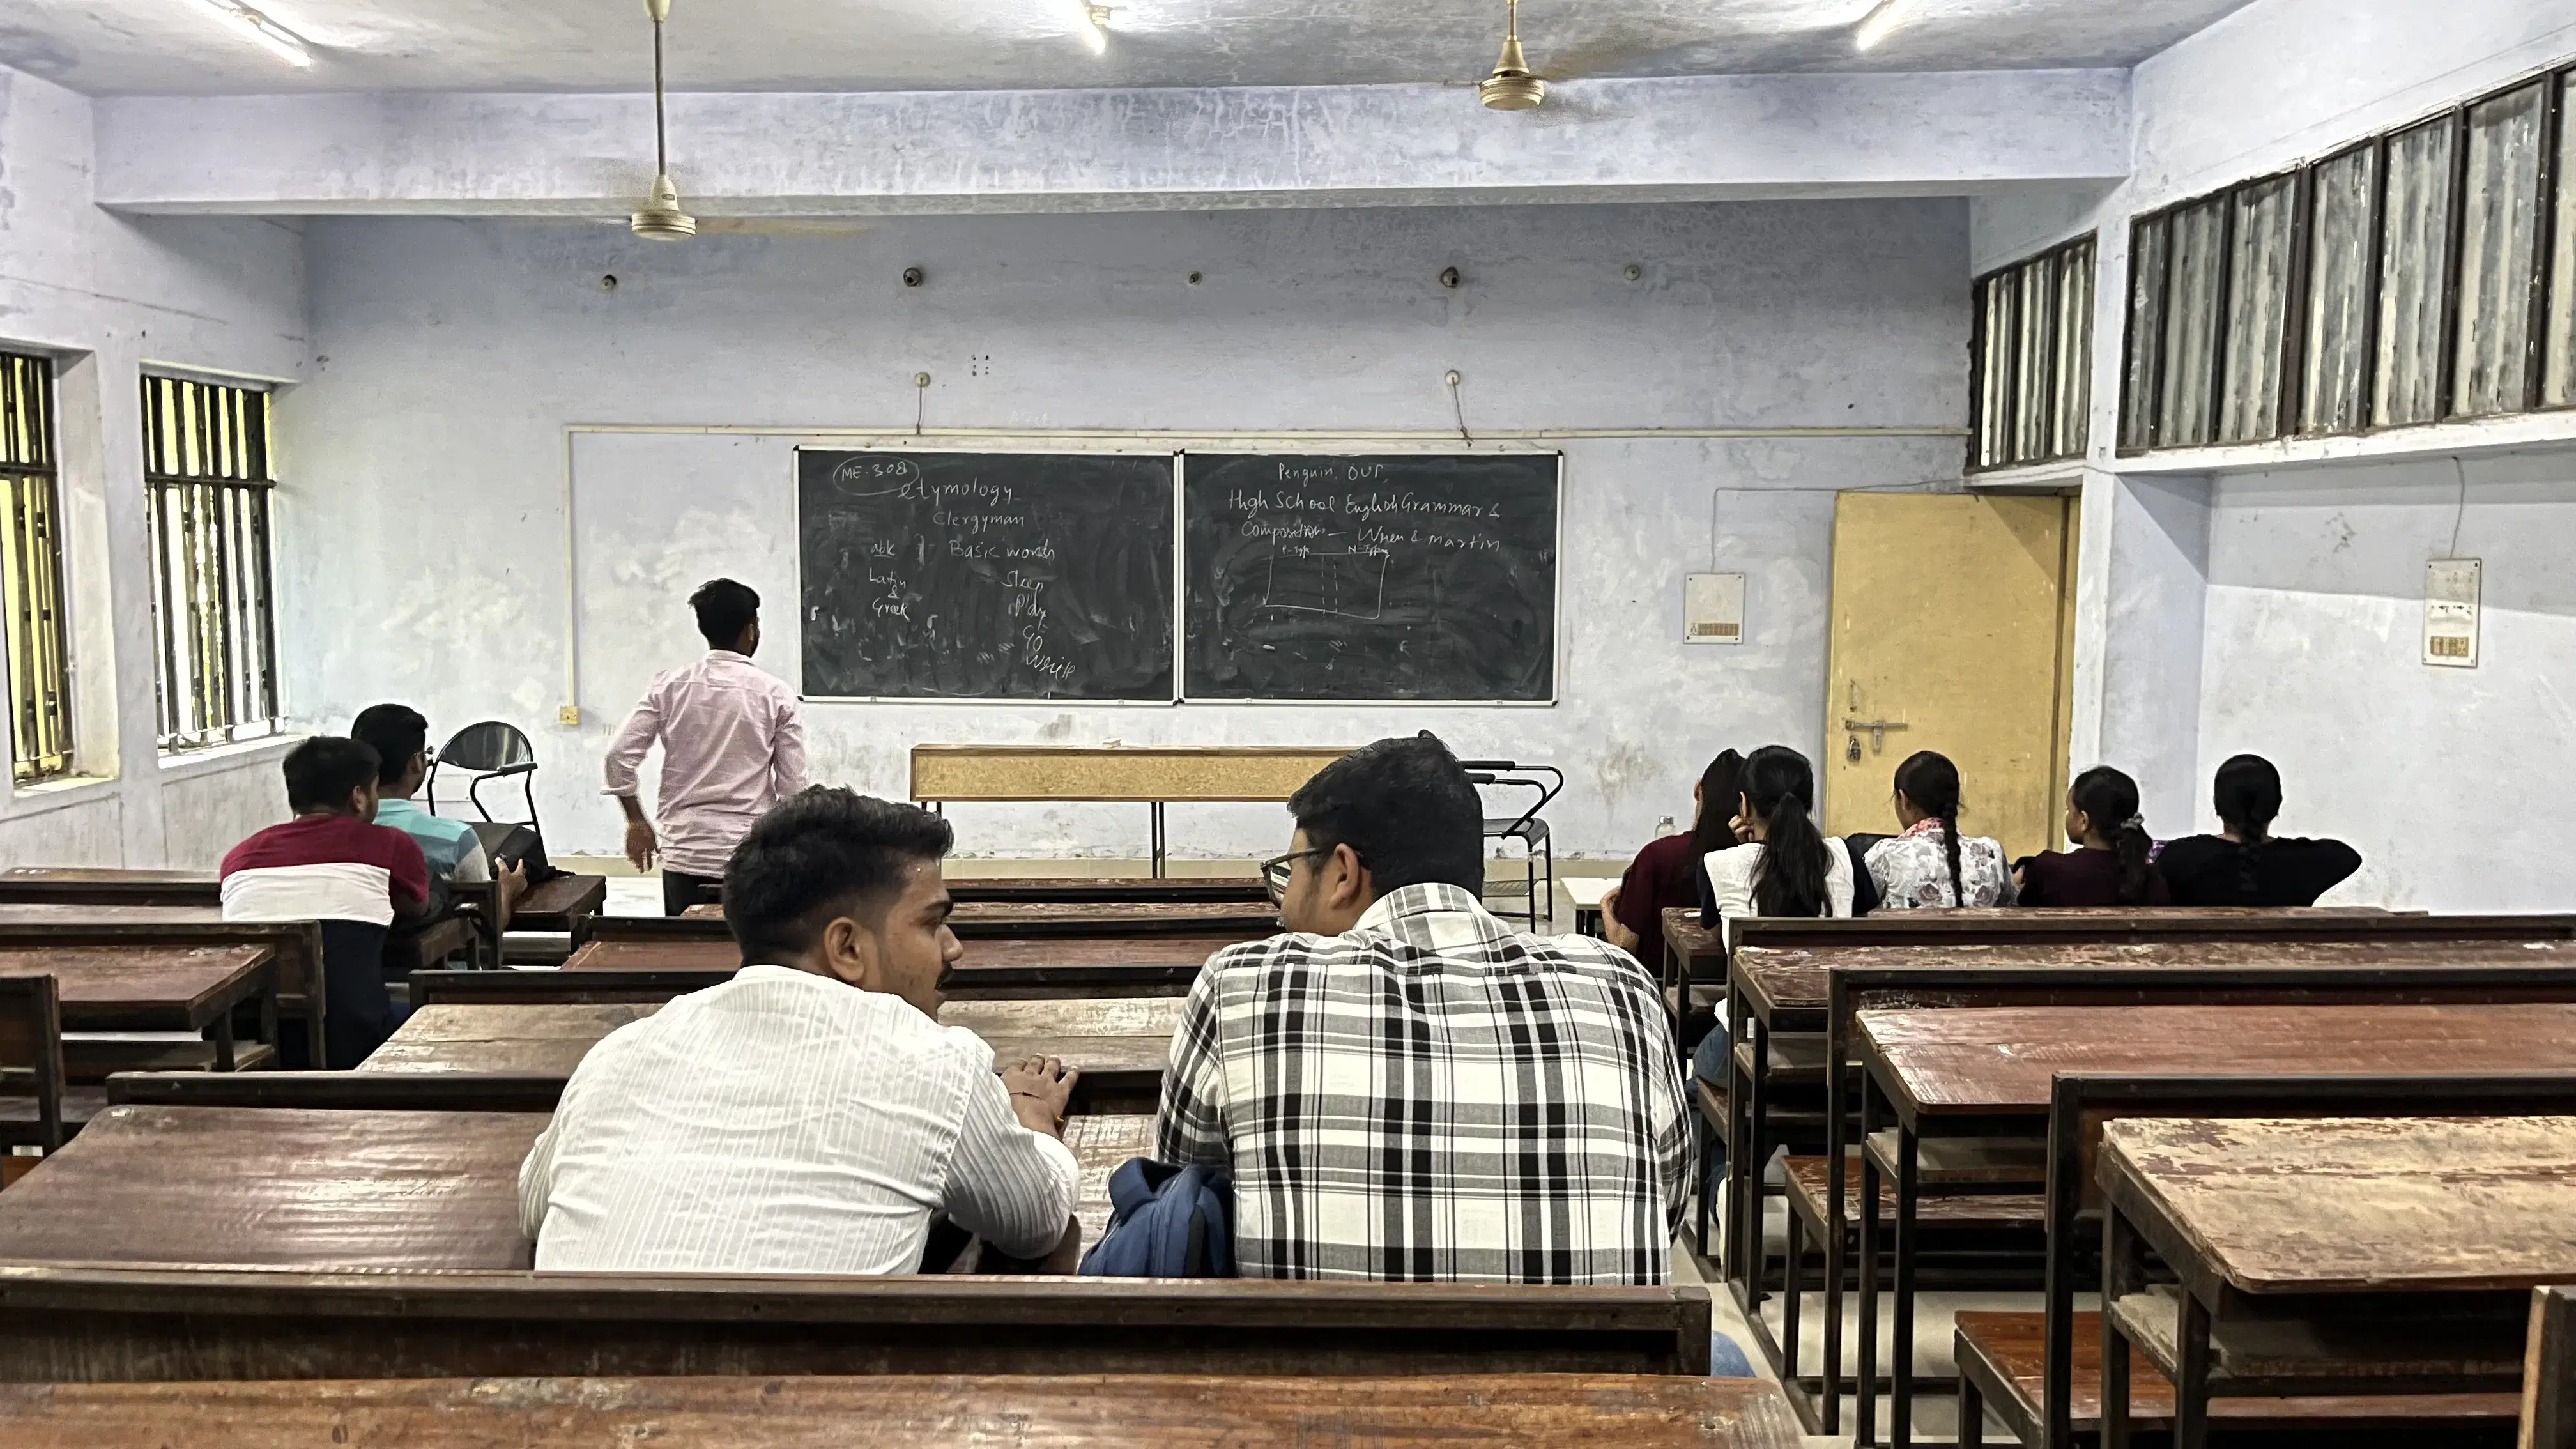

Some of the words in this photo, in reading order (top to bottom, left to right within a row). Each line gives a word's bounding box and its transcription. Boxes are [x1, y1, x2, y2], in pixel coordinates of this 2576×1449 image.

[1229, 489, 1268, 519] High
[1275, 491, 1336, 513] School
[1346, 493, 1398, 521] English
[1401, 491, 1483, 517] Grammar
[1489, 503, 1501, 518] &
[933, 511, 1024, 534] Clergyman
[1358, 525, 1404, 543] Wren
[1411, 530, 1421, 542] &
[949, 540, 1000, 559] Basic
[869, 567, 906, 588] Latin
[872, 597, 910, 622] Greek
